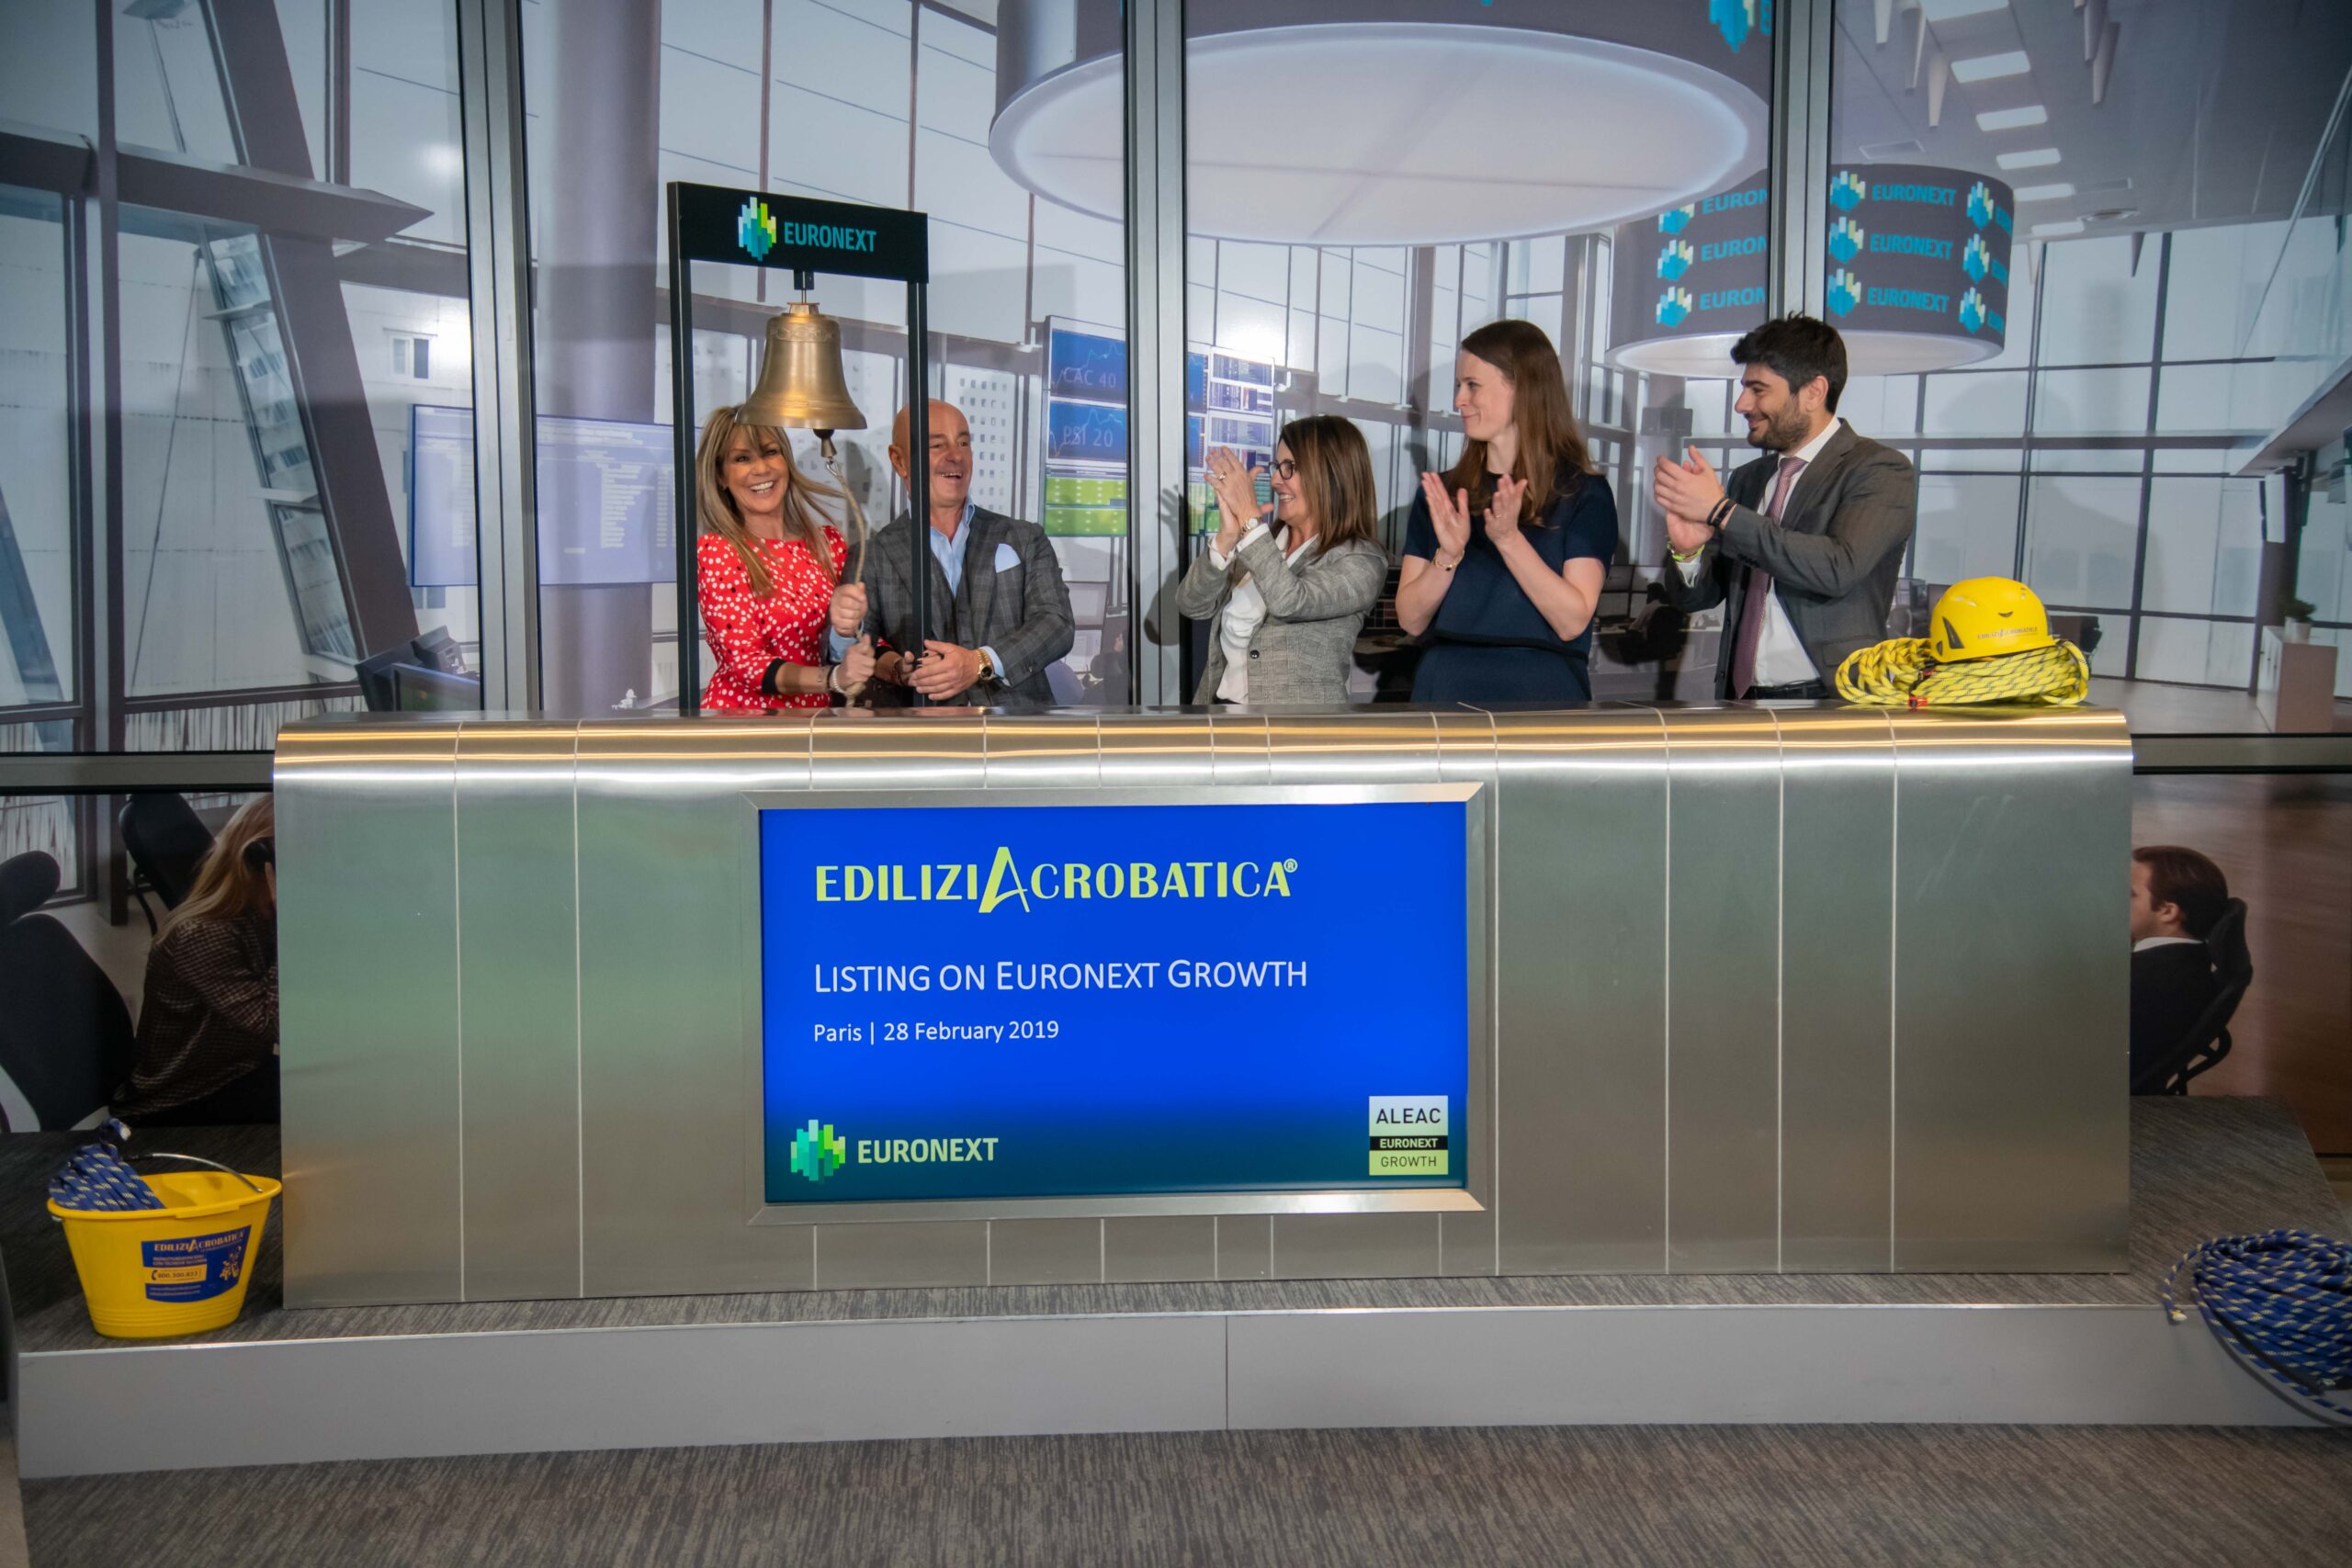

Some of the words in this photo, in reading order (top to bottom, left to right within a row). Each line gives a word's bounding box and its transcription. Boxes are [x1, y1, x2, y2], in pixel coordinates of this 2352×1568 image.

[1871, 184, 1956, 206] EURONEXT
[784, 221, 877, 252] EURONEXT
[1870, 233, 1953, 260] EURONEXT
[1867, 287, 1950, 313] EURONEXT
[1064, 367, 1094, 386] CAC
[1099, 372, 1116, 389] 40
[1093, 428, 1114, 447] 20
[939, 964, 986, 991] ON
[997, 961, 1161, 990] EURONEXT
[1168, 959, 1306, 988] GROWTH
[814, 1023, 863, 1043] Paris
[884, 1022, 909, 1041] 28
[915, 1021, 1004, 1043] February
[1009, 1021, 1059, 1039] 2019
[1375, 1107, 1442, 1124] ALEAC
[858, 1137, 1000, 1164] EURONEXT
[1379, 1138, 1439, 1149] EURONEXT
[1381, 1156, 1437, 1168] GROWTH
